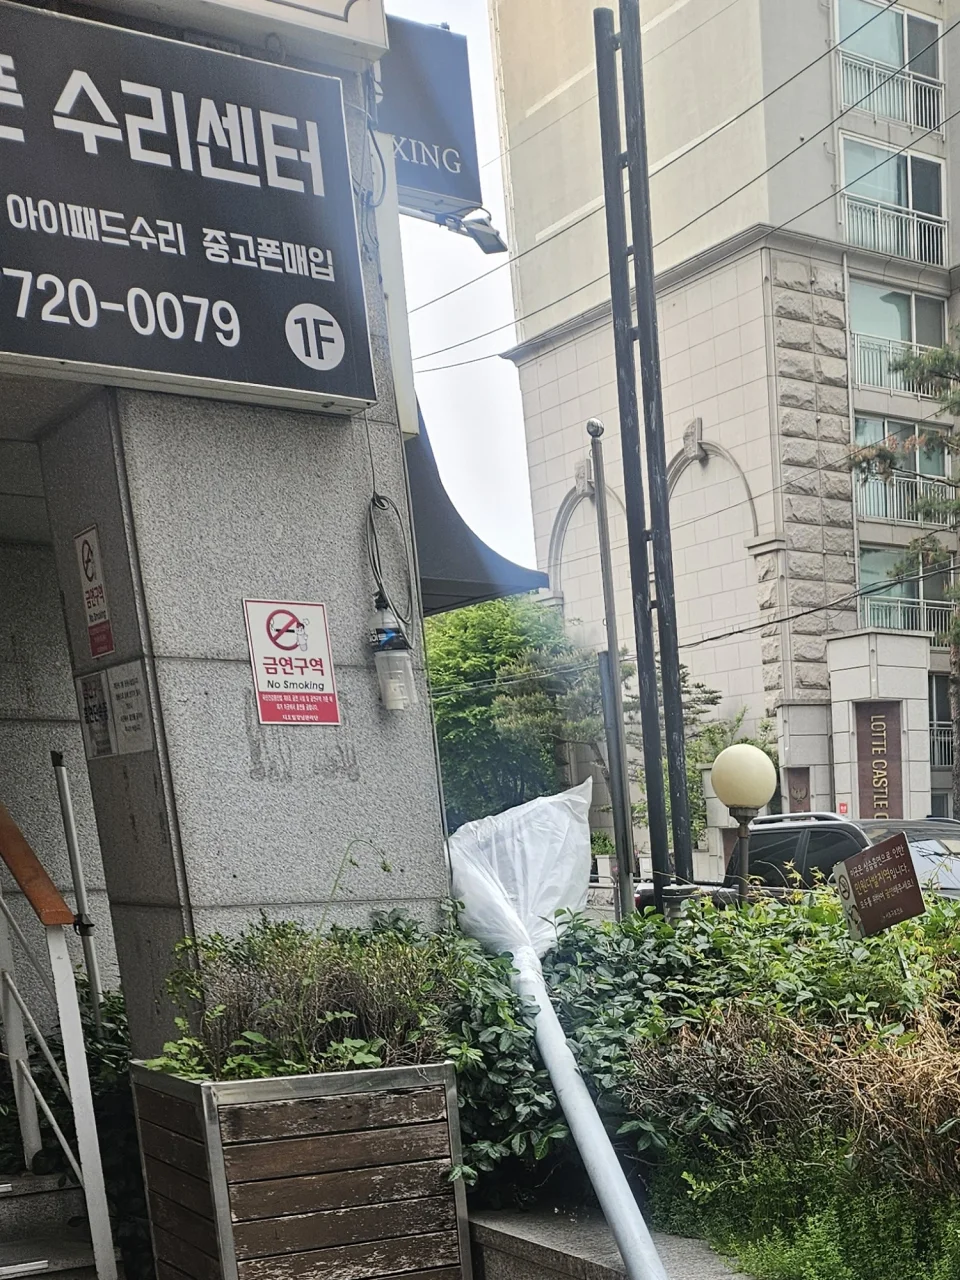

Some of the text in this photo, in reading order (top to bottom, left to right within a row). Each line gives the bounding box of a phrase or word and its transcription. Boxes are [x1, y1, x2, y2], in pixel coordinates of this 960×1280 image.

[52, 69, 326, 198] 수리센터
[7, 194, 336, 282] 아이패드수리 중고폰매입
[3, 267, 337, 360] 720-0079 1F
[262, 656, 325, 677] 금연구역
[267, 680, 325, 692] No Smoking
[870, 714, 887, 756] LOTTE
[872, 759, 889, 809] CASTLE
[892, 845, 905, 859] 인한
[854, 862, 911, 896] 민원다발지역입니다.
